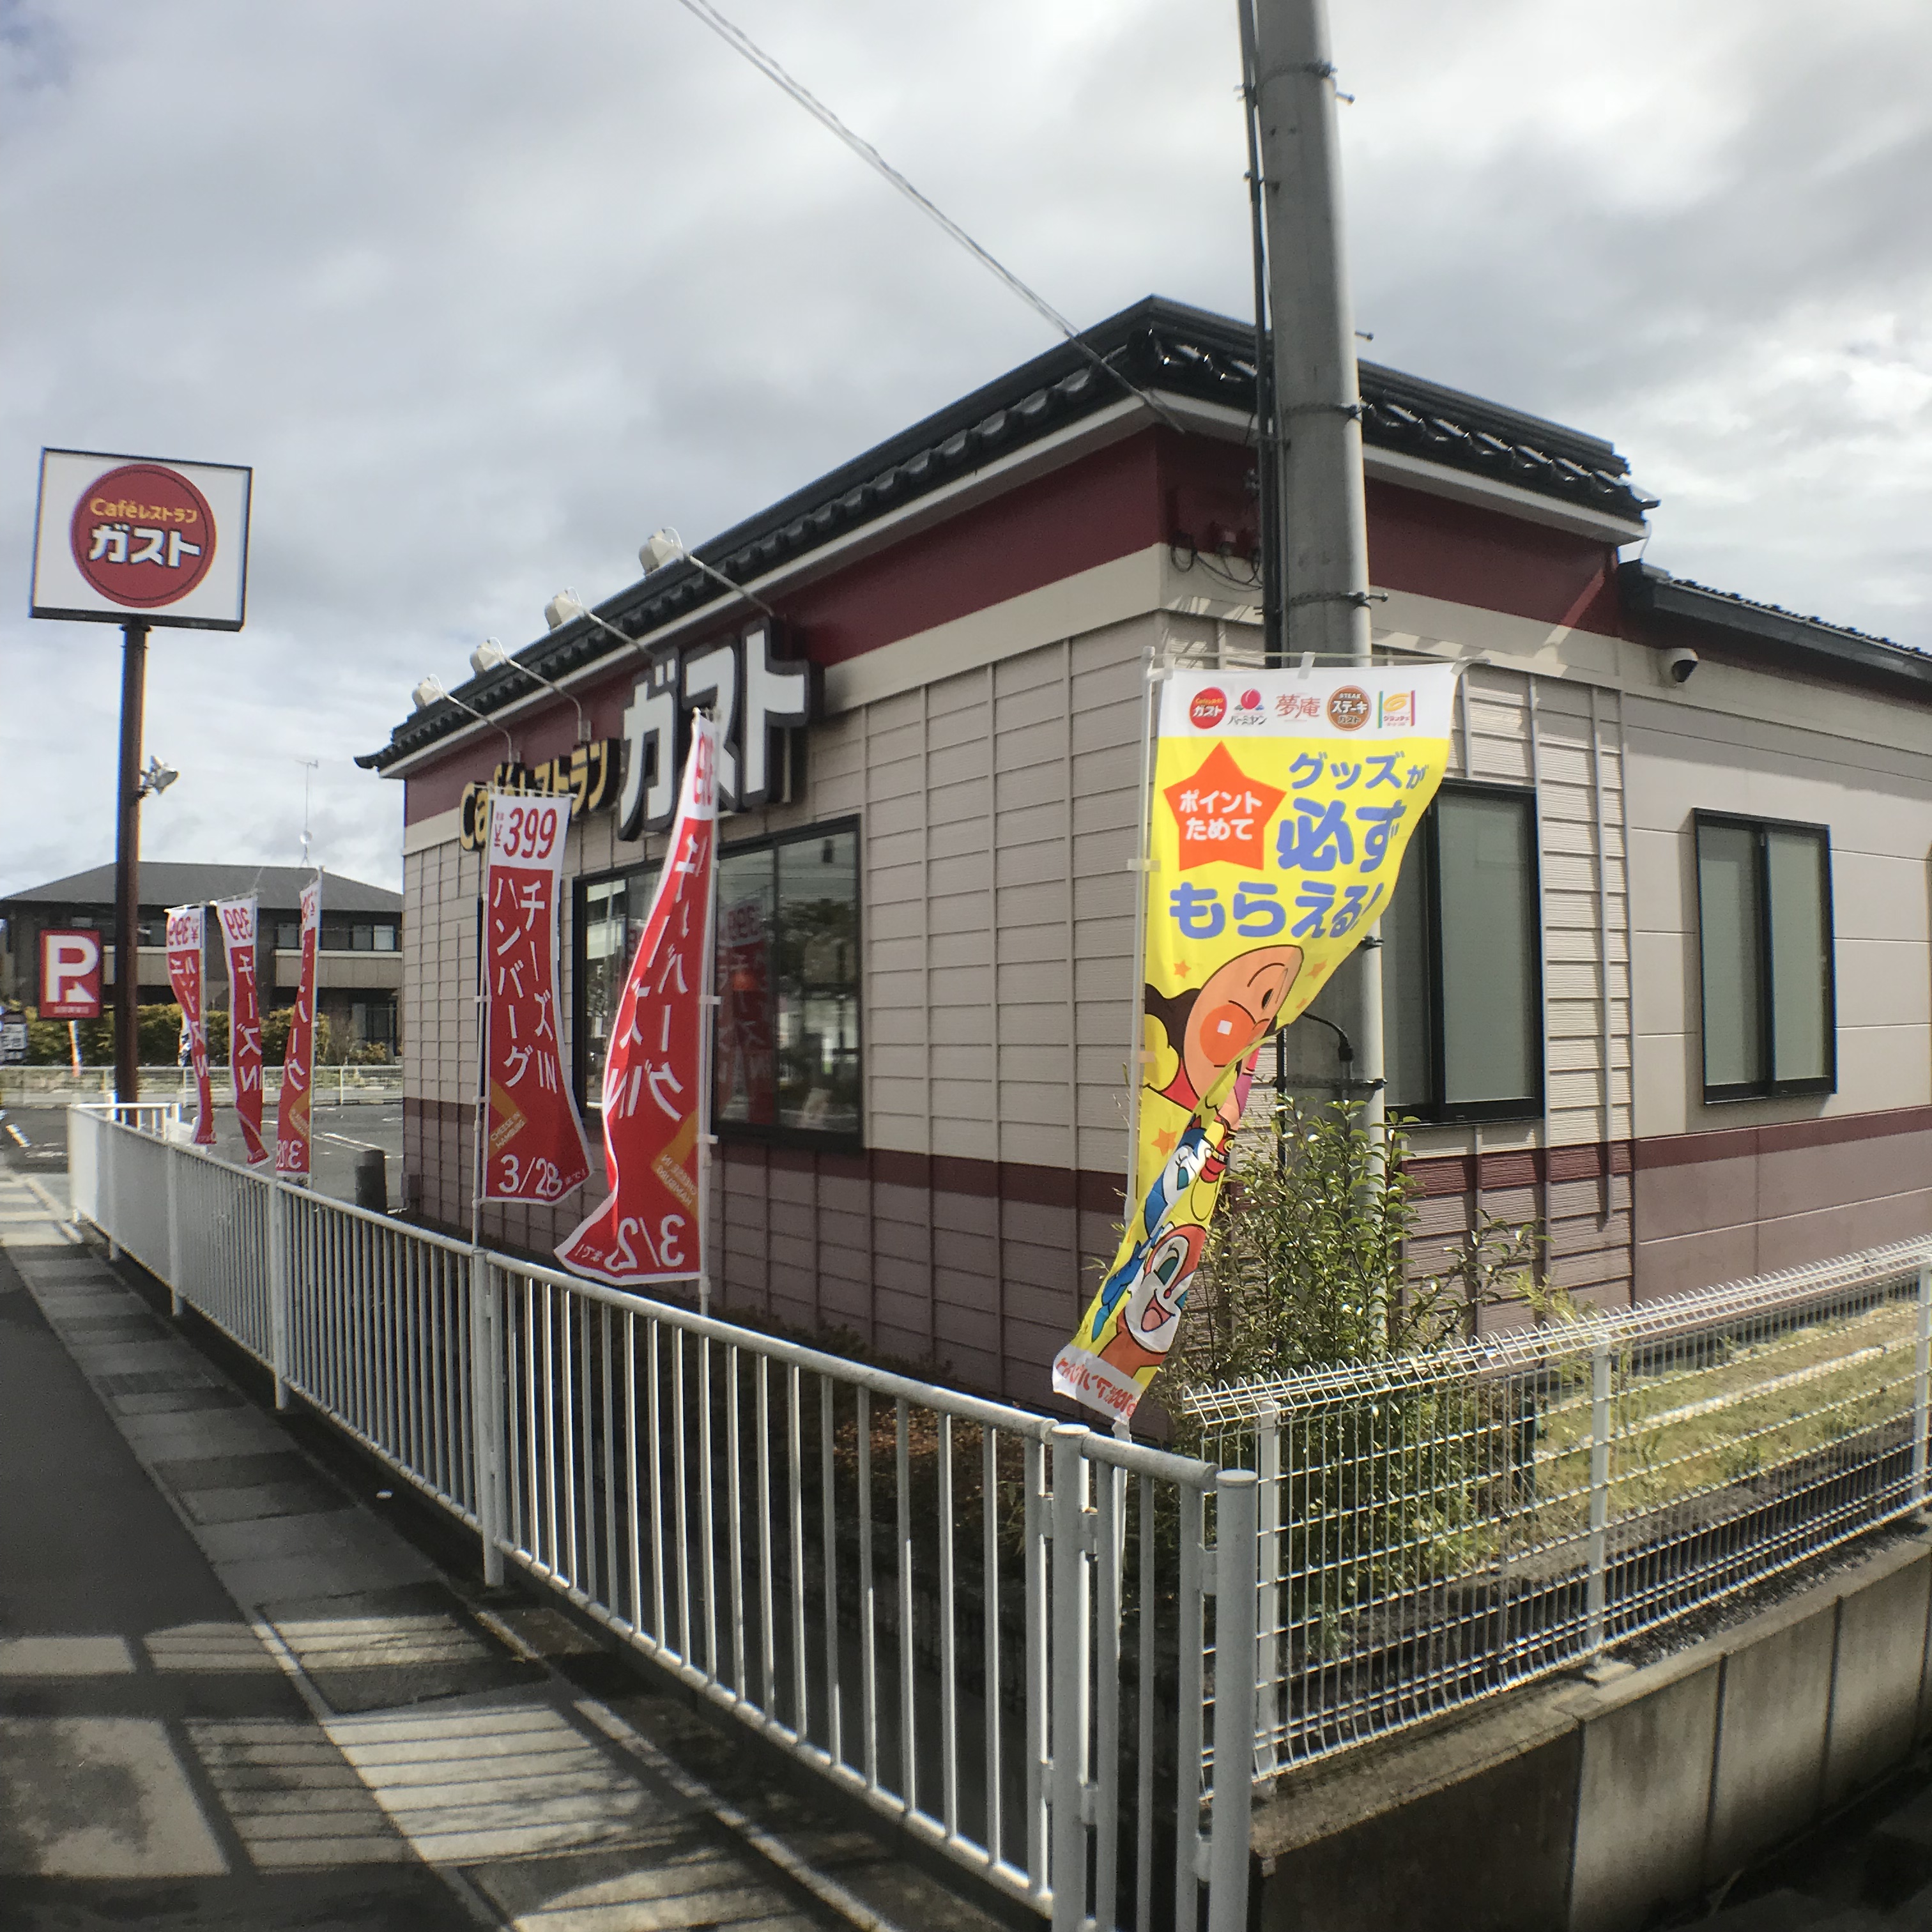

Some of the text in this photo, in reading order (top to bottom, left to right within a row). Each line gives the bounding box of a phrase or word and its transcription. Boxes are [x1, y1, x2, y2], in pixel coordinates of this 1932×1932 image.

[88, 522, 201, 568] ガスト
[1193, 705, 1223, 717] ガスト
[1227, 714, 1268, 726] バーミヤン
[1275, 693, 1321, 719] 夢庵
[1330, 700, 1368, 714] ステーキ
[618, 626, 807, 831] ガスト
[1289, 750, 1430, 791] グッズが
[1179, 790, 1263, 814] ポイント
[1185, 818, 1255, 841] ためて
[1276, 797, 1407, 873] 必ず
[46, 935, 98, 1003] P
[493, 877, 534, 1087] ハンバーグ
[519, 879, 558, 1094] チーズIN
[498, 1154, 563, 1197] 3/28
